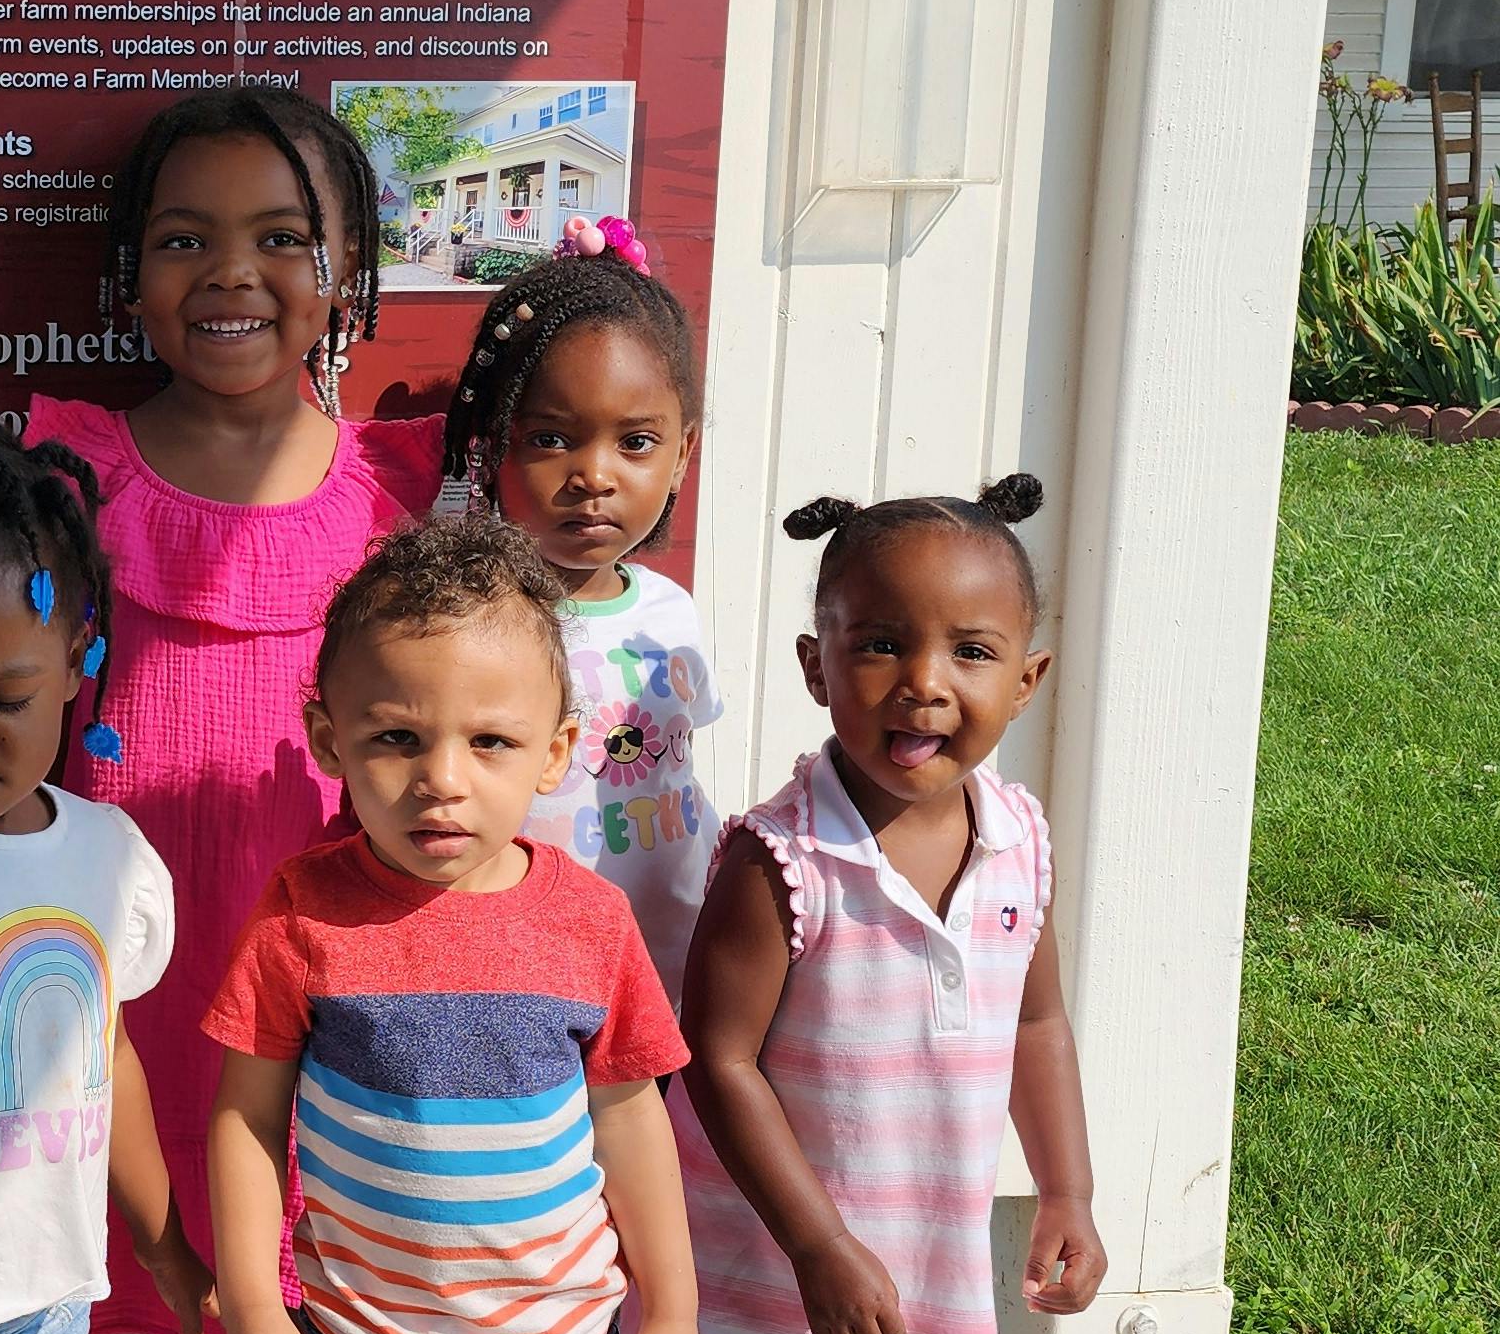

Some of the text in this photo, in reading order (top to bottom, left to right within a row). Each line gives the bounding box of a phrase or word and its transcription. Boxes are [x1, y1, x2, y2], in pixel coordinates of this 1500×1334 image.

[73, 72, 87, 89] a
[93, 68, 145, 89] Farm
[151, 68, 236, 89] Member
